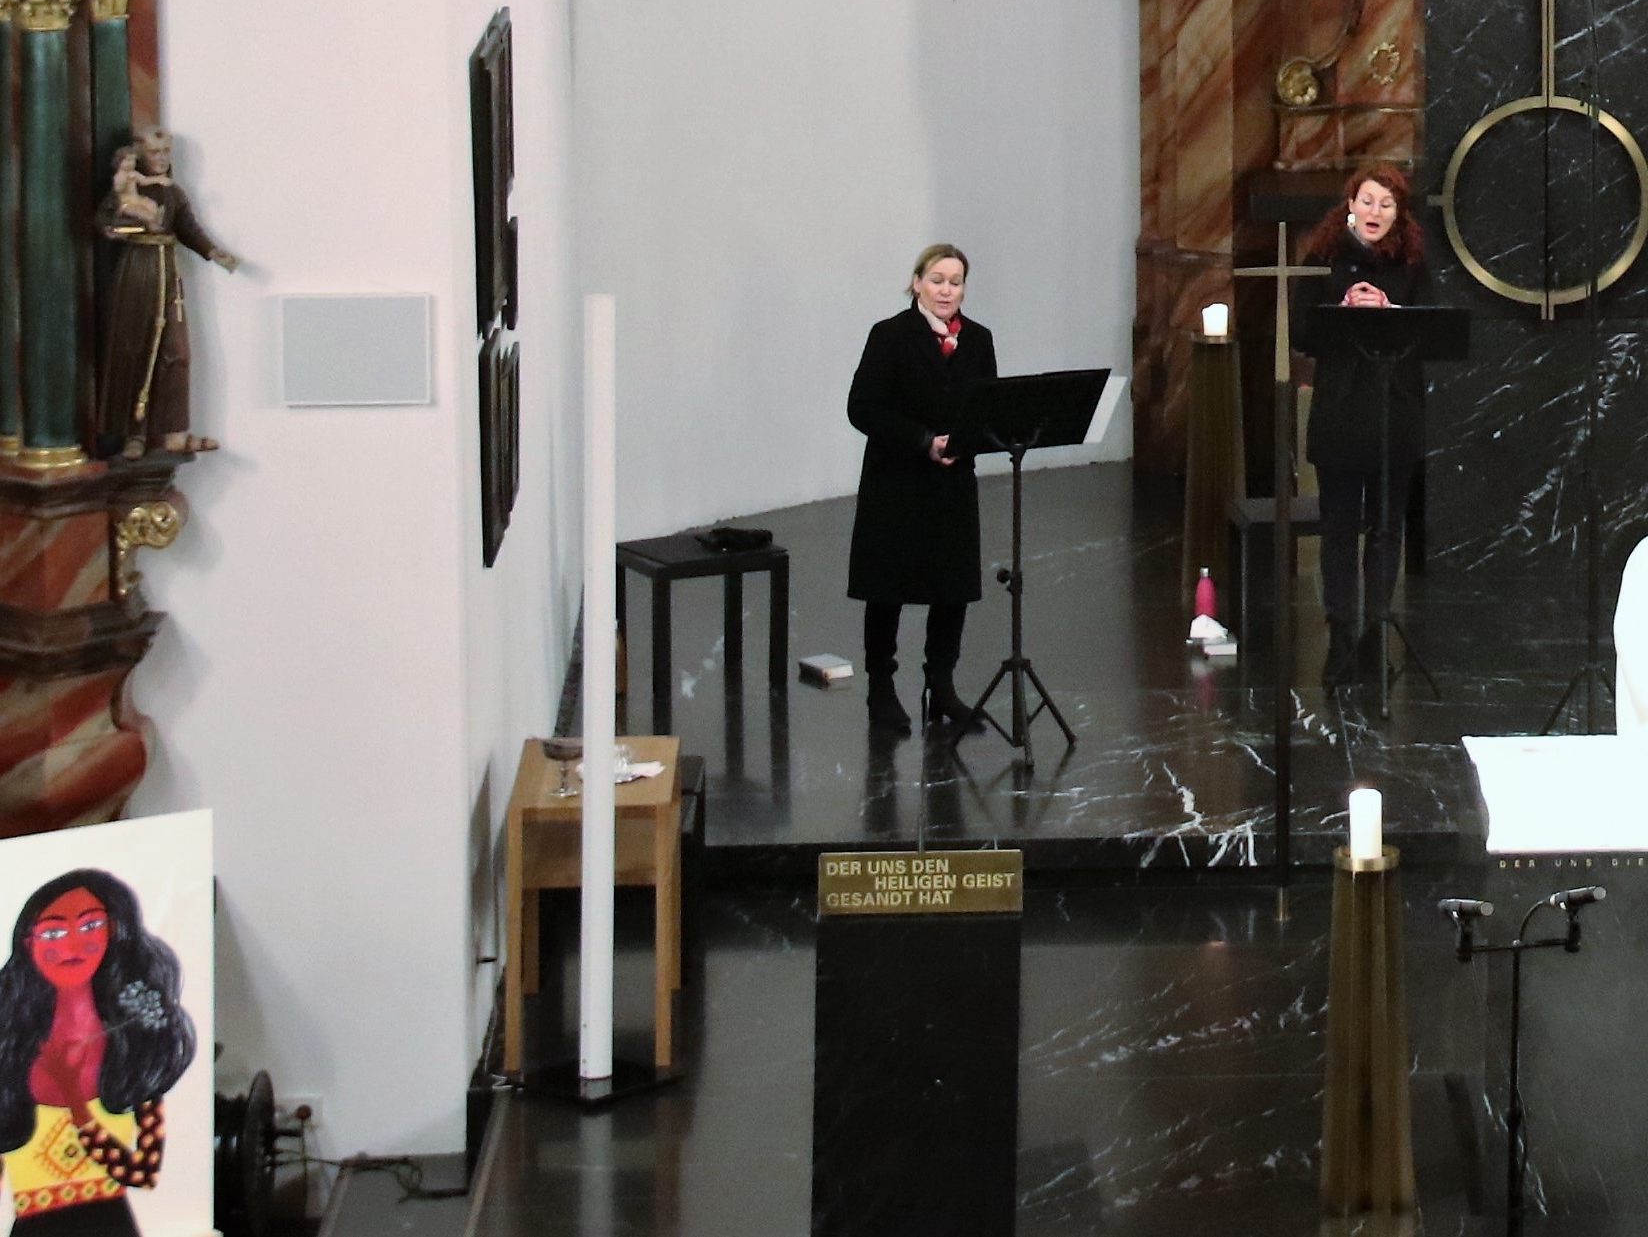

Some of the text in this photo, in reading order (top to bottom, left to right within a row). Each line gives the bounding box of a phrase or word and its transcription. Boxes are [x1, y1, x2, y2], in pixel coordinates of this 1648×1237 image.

[826, 859, 949, 876] DER UNS DEN
[1499, 859, 1536, 868] DER
[1555, 858, 1593, 868] UNS
[1611, 858, 1644, 867] DIE
[875, 872, 1015, 890] HEILIGEN GEIST
[826, 890, 954, 907] GESANDT HAT
